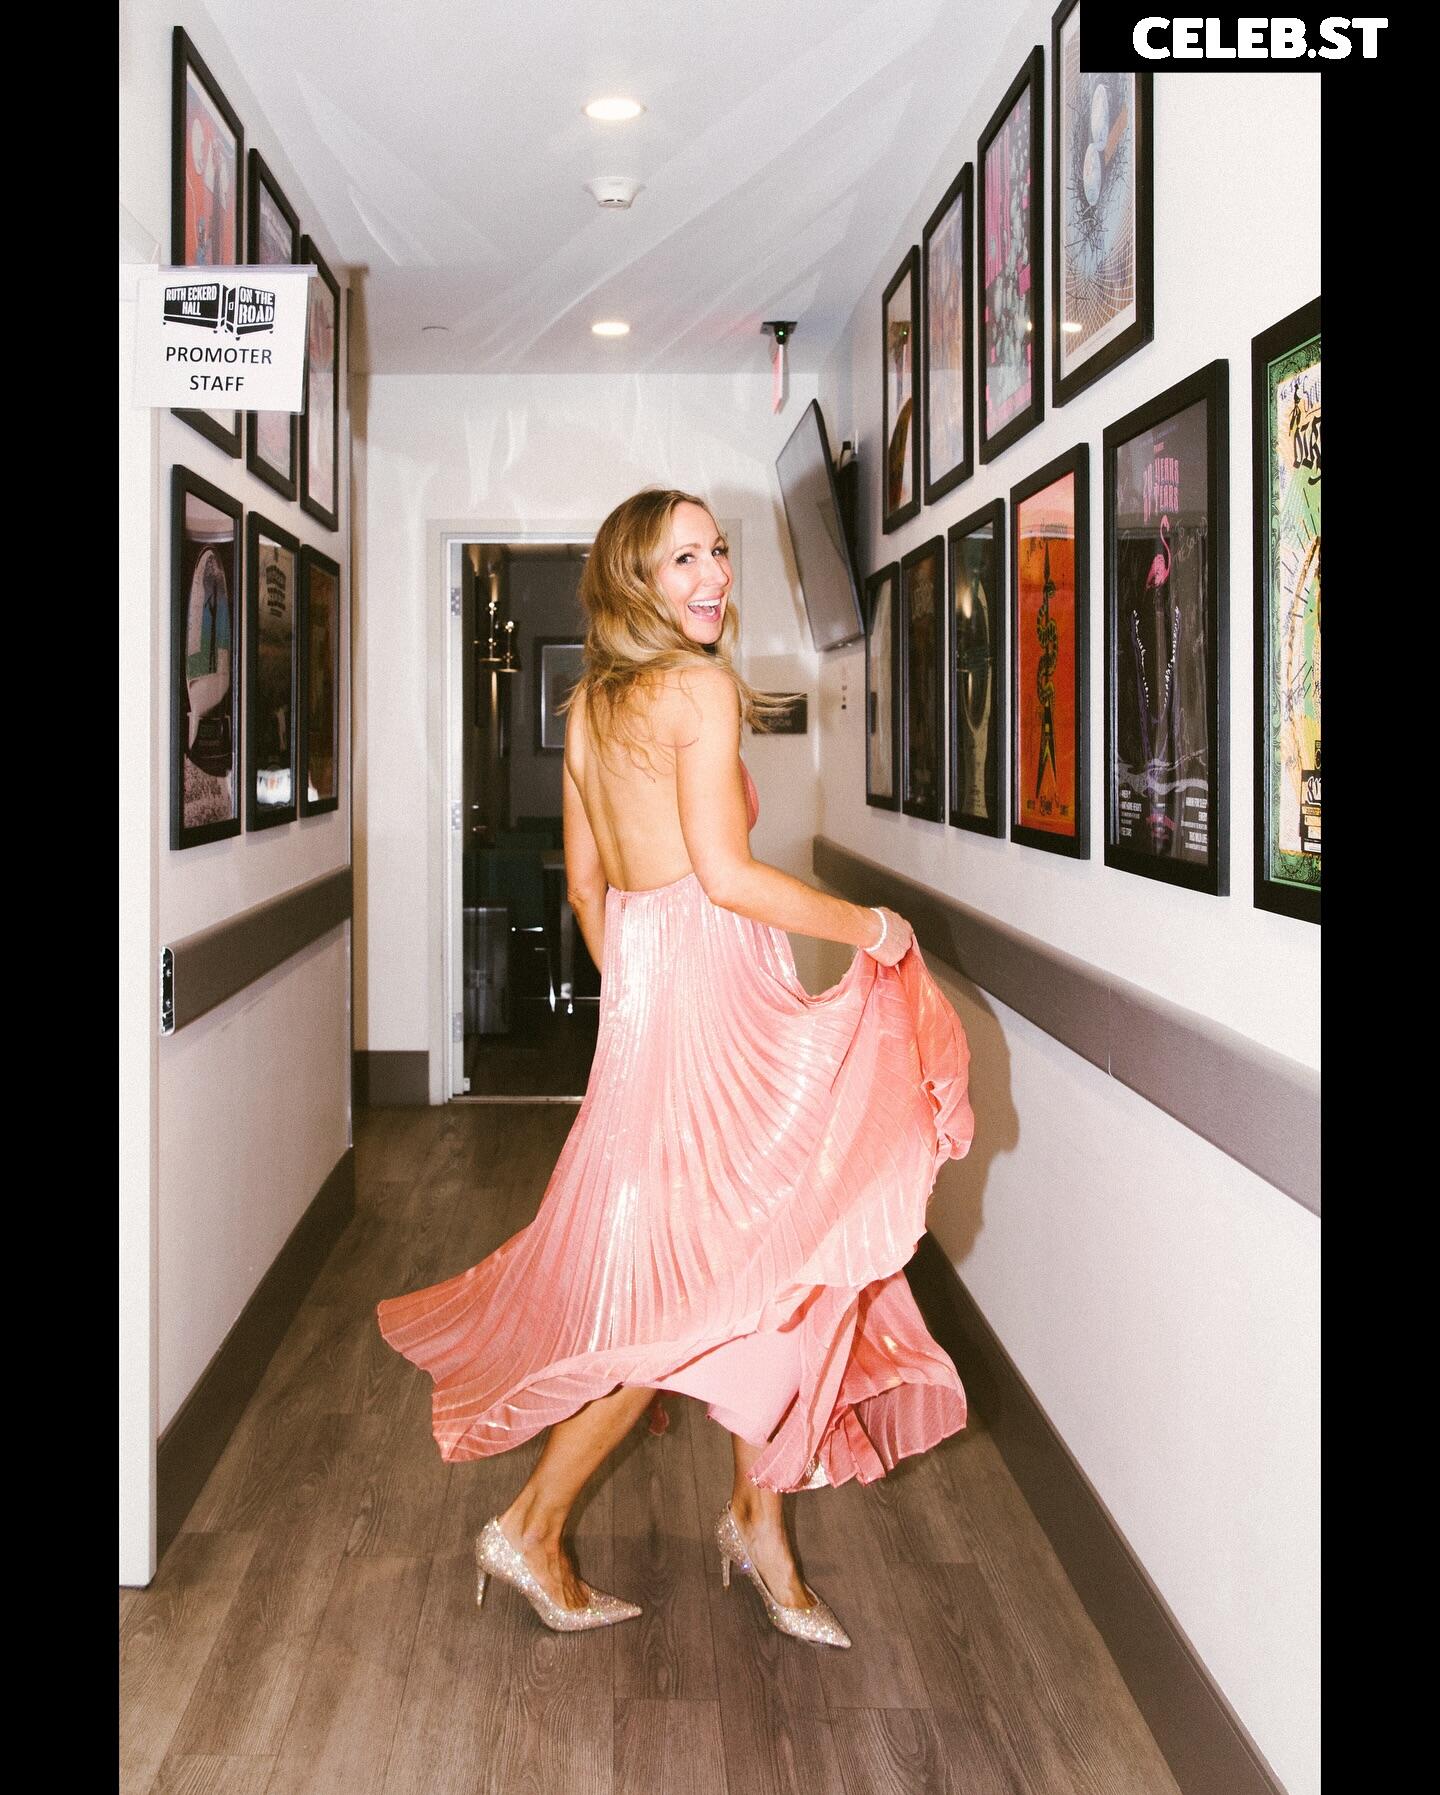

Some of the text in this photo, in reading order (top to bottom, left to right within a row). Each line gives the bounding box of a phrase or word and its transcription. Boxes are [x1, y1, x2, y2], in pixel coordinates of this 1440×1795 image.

[166, 285, 217, 301] RUTH ECKERD
[240, 287, 274, 305] ON THE
[182, 302, 201, 316] HALL
[238, 304, 274, 324] ROAD
[166, 346, 272, 364] PROMOTER
[190, 375, 245, 392] STAFF
